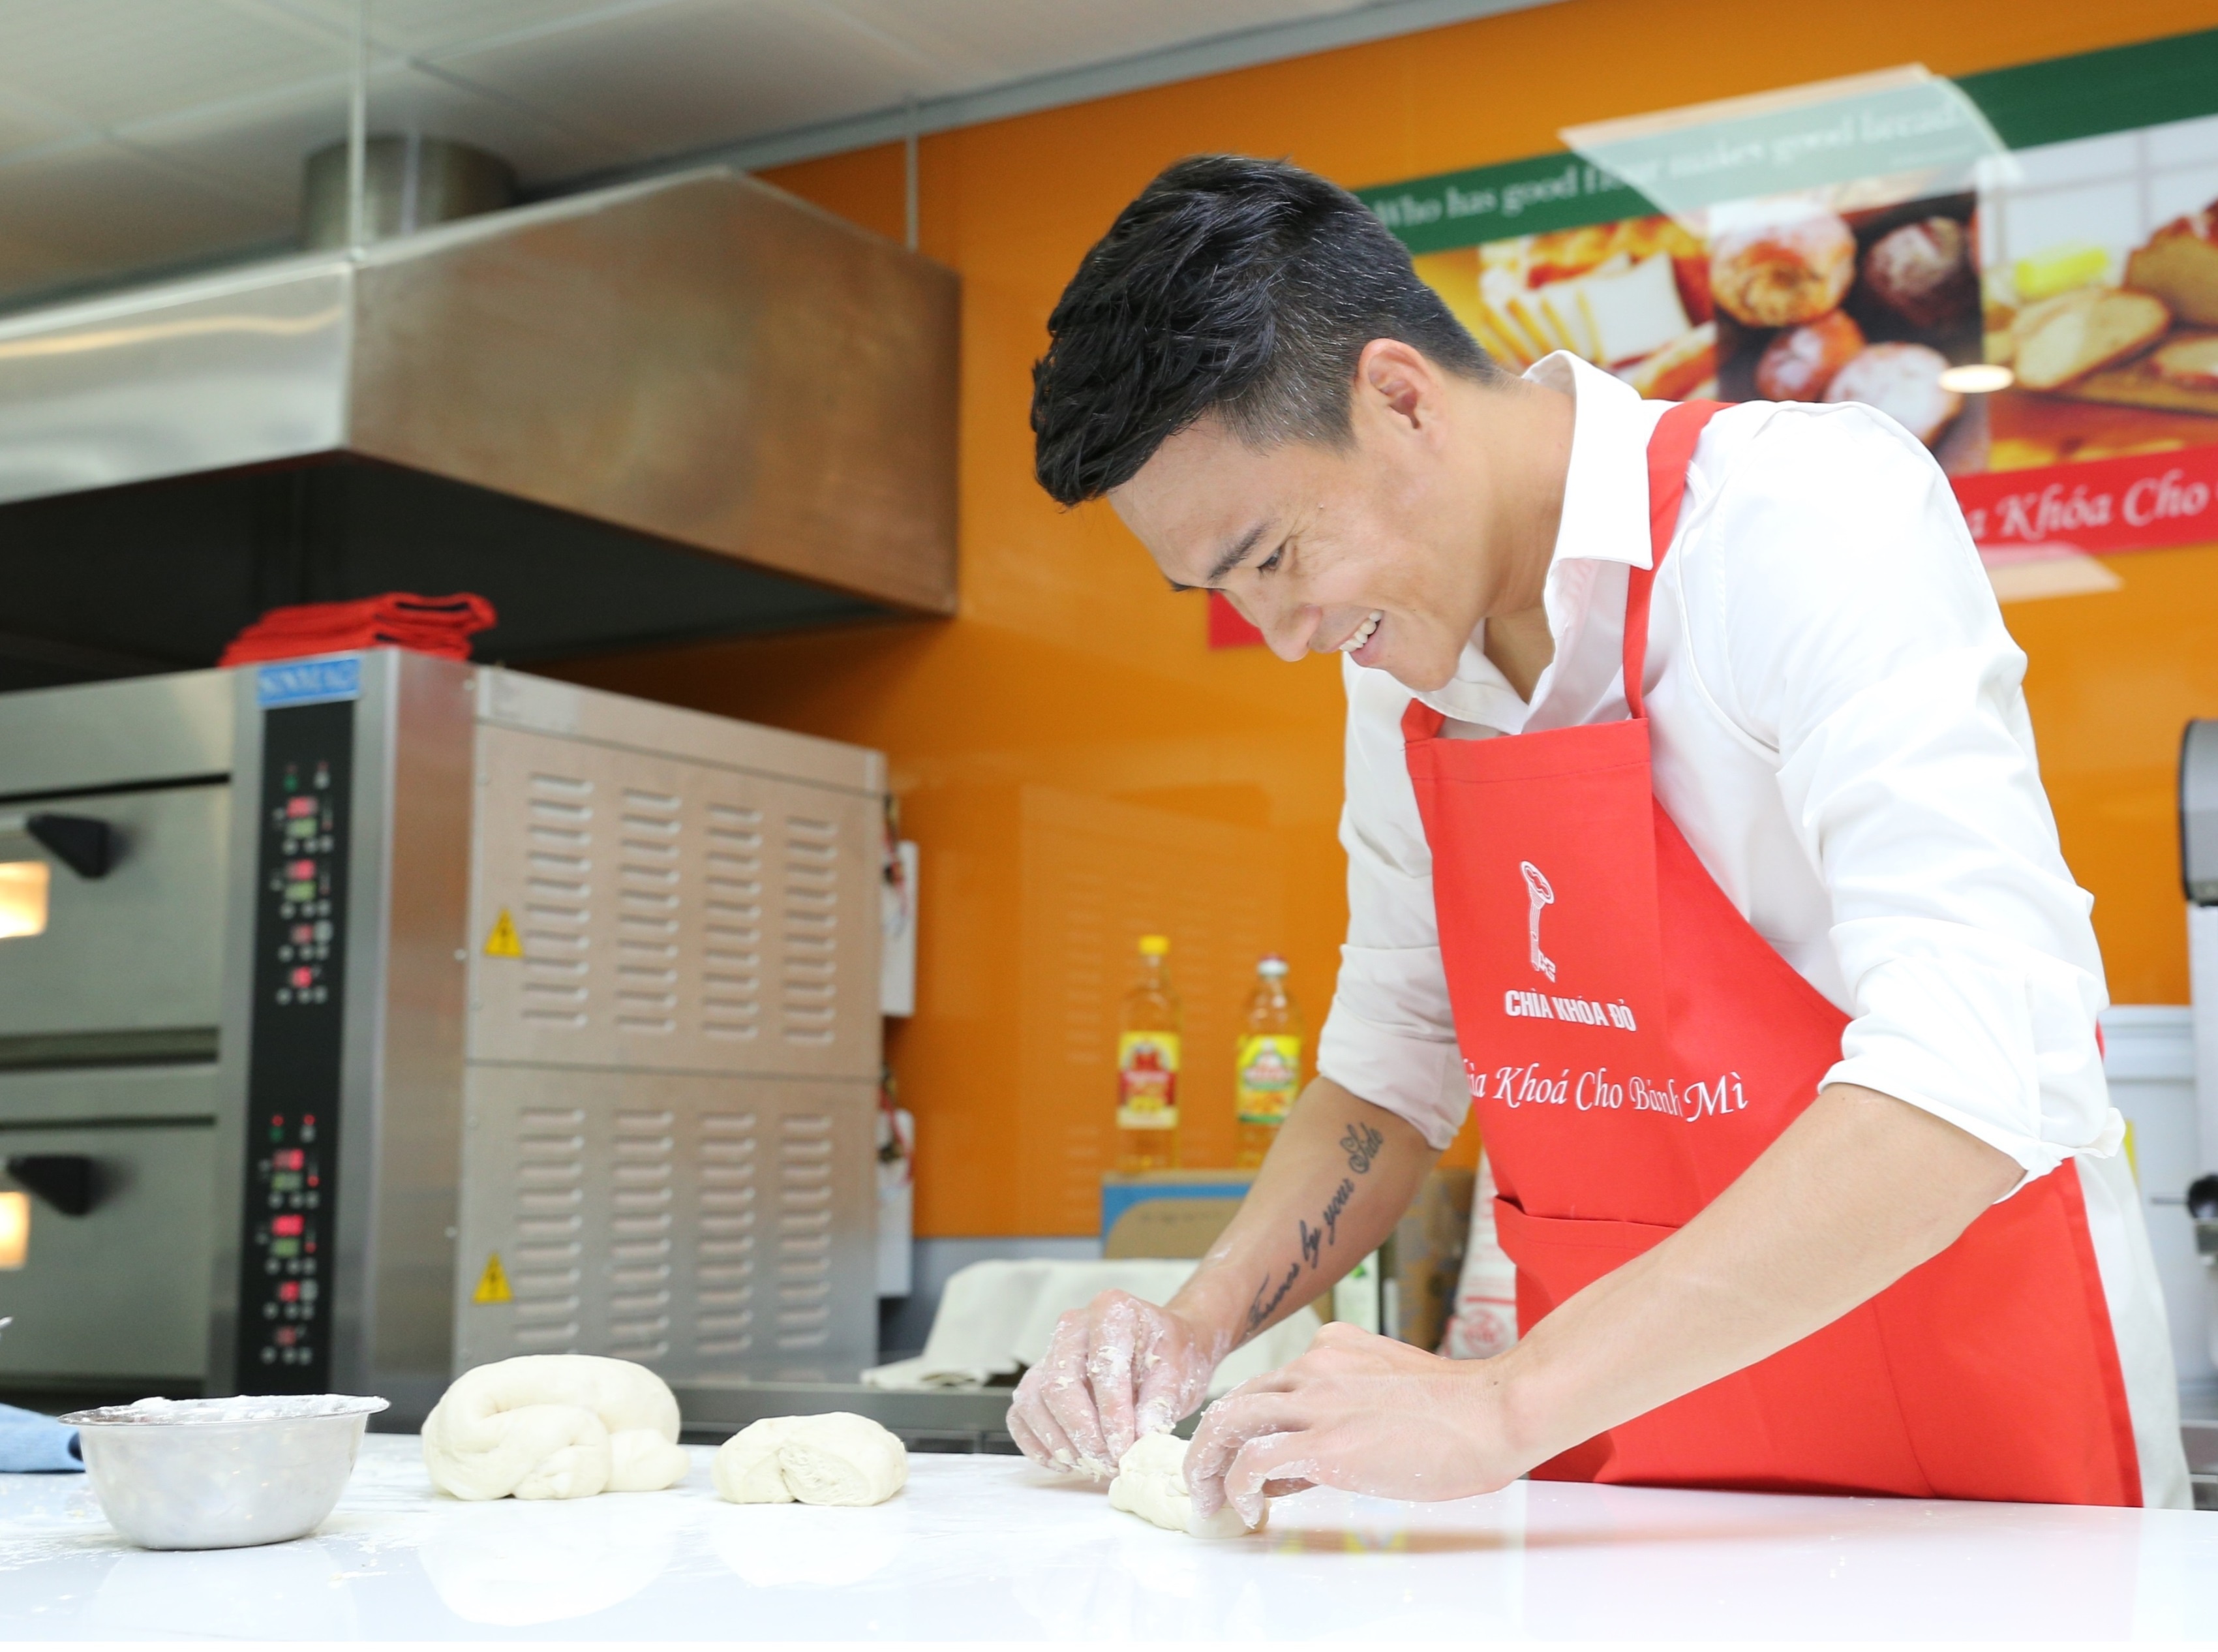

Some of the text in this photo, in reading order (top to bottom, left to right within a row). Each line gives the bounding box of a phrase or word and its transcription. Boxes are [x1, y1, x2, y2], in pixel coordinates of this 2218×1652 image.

[1444, 186, 1498, 219] has
[1502, 164, 1578, 217] good
[1994, 483, 2113, 542] Khóa
[2121, 468, 2210, 527] Cho
[1505, 988, 1637, 1032] CHÌA KHÓA ĐỎ
[1492, 1063, 1570, 1109] Khoá
[1575, 1067, 1623, 1110] Cho
[1629, 1077, 1683, 1117] Bánh
[1684, 1071, 1748, 1122] Mì
